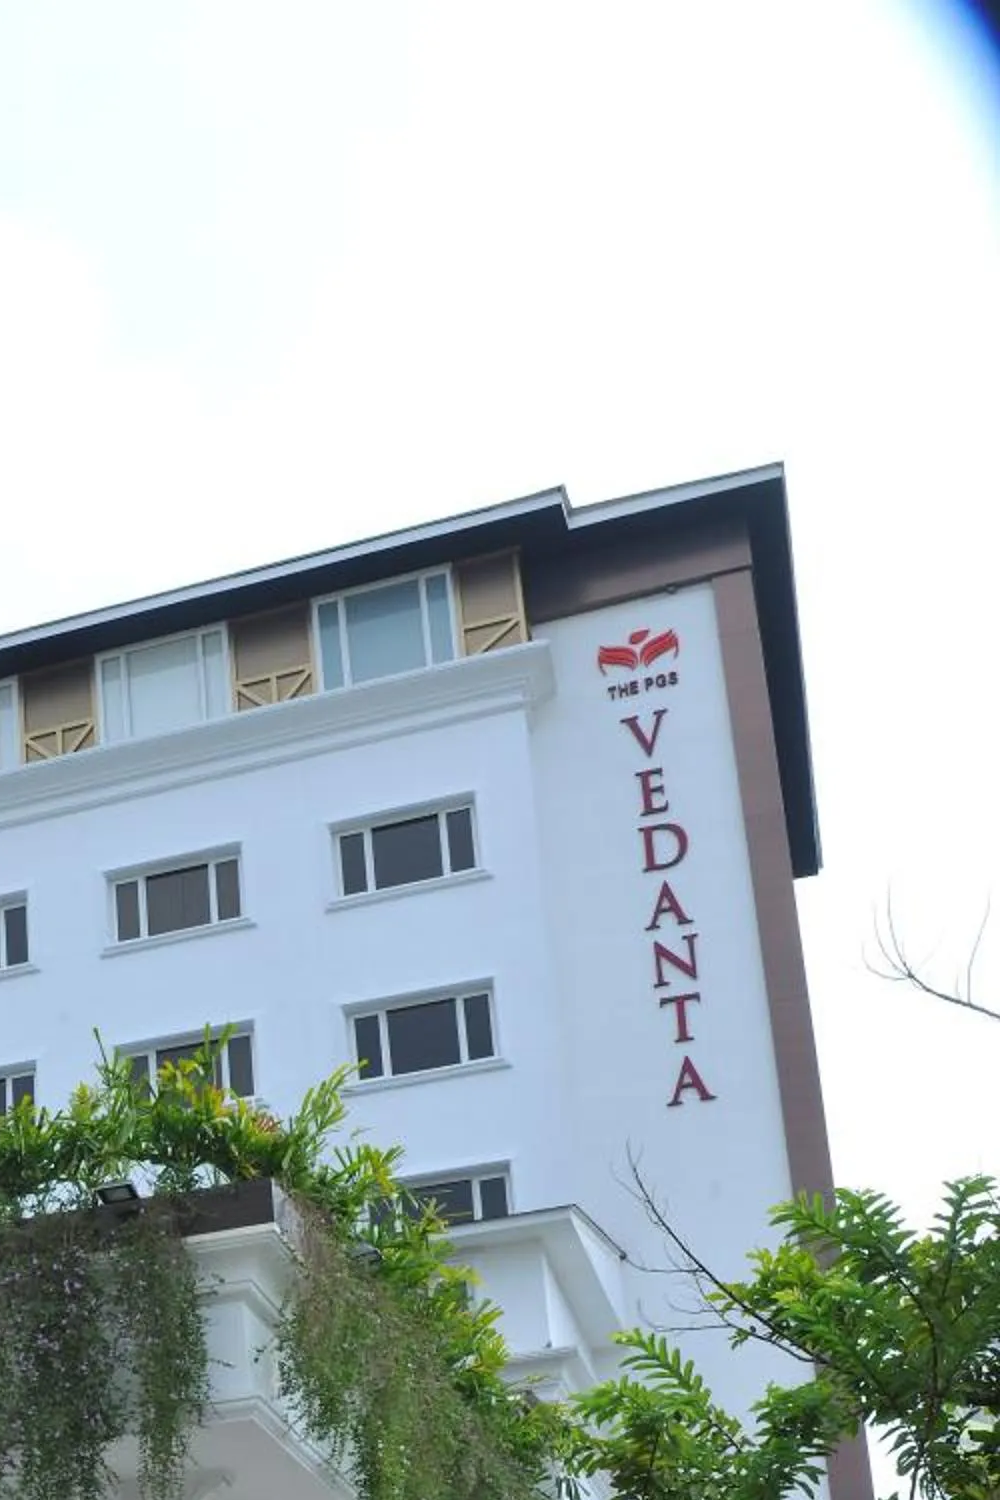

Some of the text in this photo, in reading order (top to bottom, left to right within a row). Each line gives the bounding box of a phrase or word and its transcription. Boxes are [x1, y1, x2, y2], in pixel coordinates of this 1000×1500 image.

[607, 671, 678, 701] THE PGS
[619, 708, 718, 1108] VEDANTA
